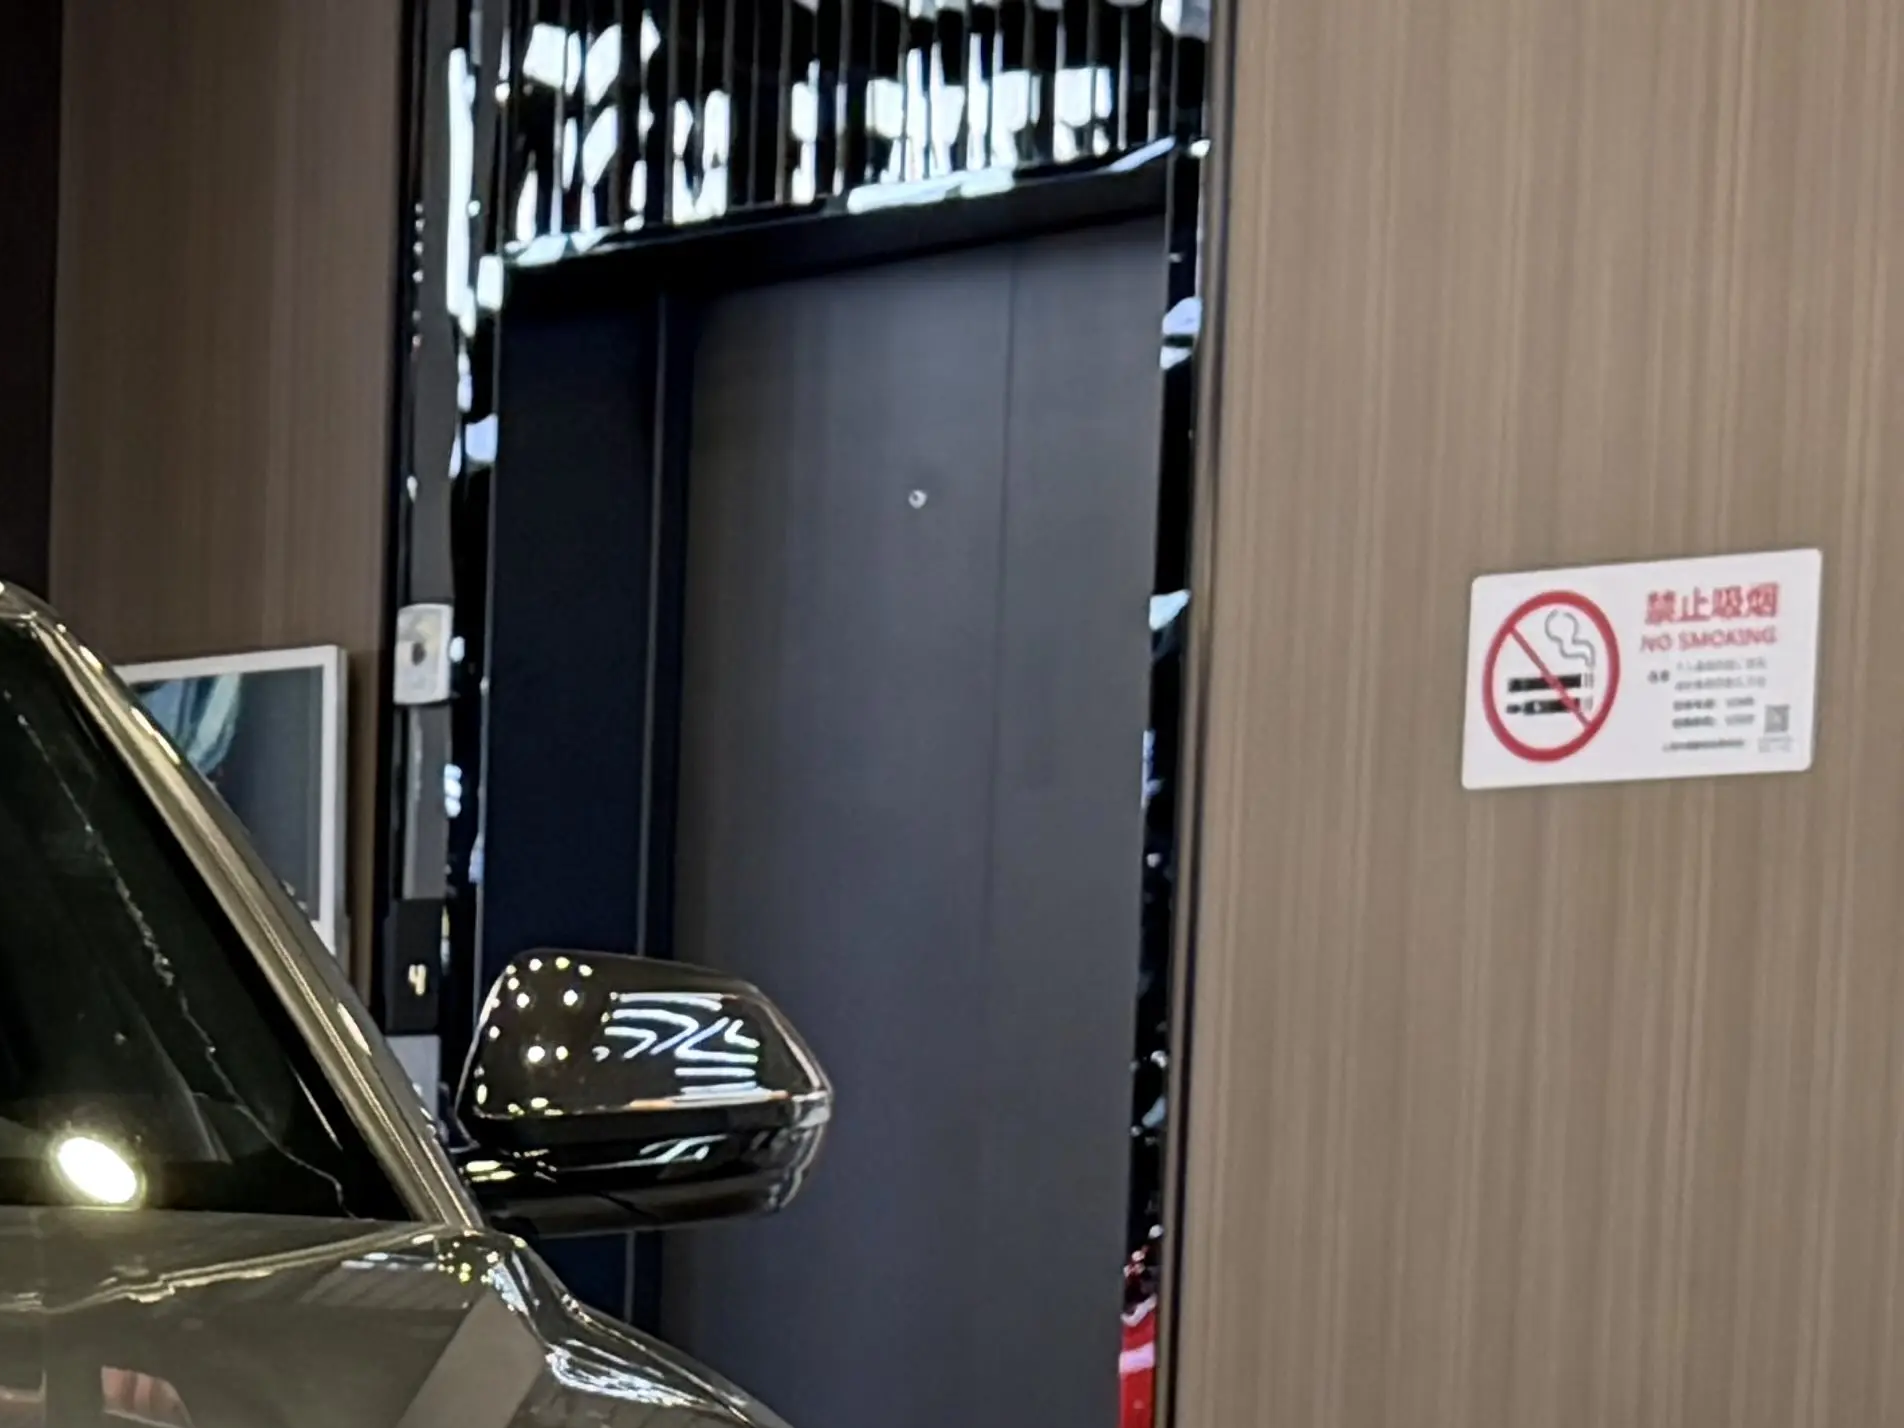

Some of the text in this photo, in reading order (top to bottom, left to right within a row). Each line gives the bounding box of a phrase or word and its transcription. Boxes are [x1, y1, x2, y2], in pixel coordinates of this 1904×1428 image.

[1645, 582, 1779, 625] 禁止吸烟
[1640, 625, 1777, 652] NO SMOKING
